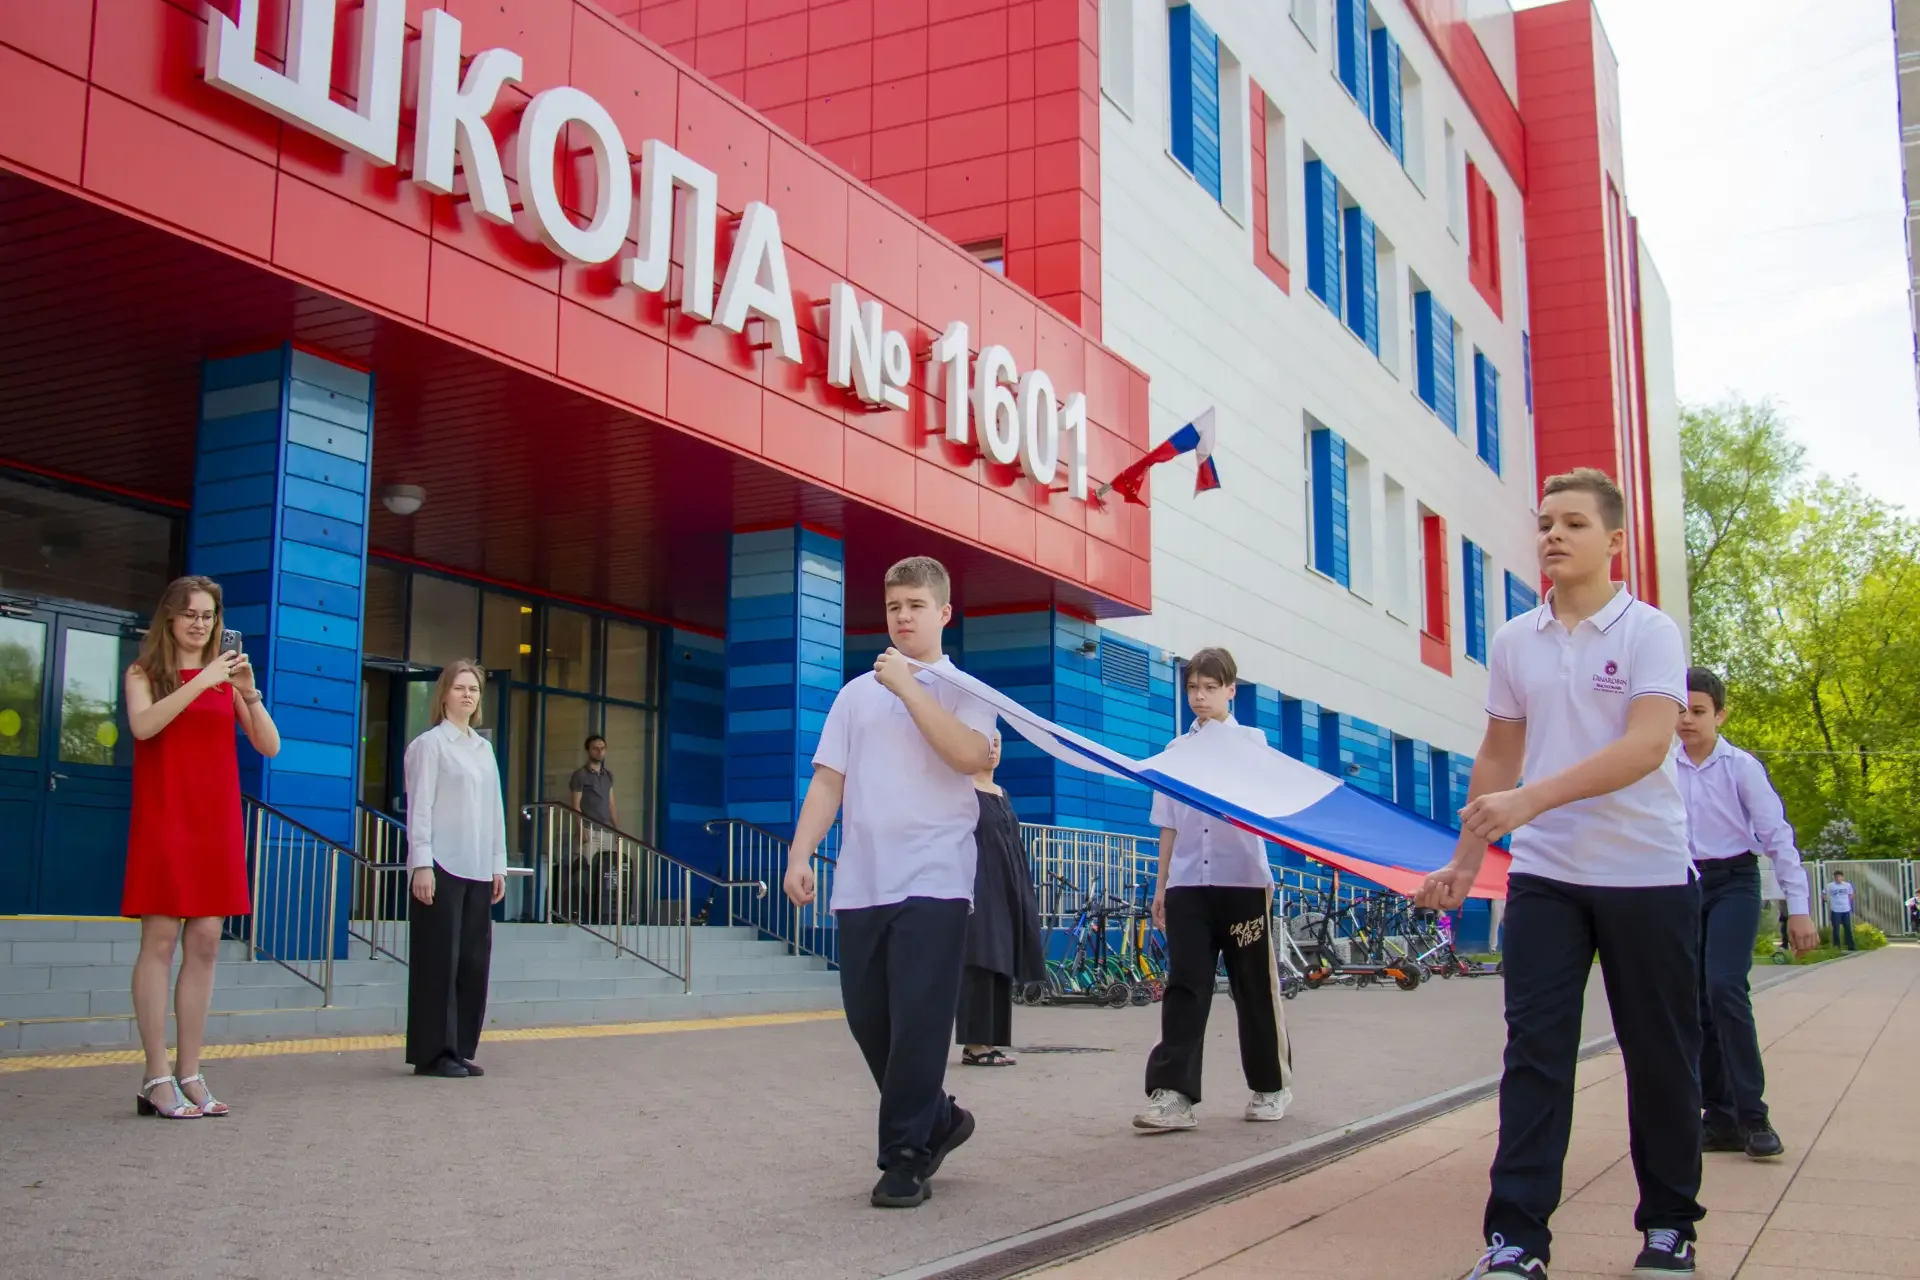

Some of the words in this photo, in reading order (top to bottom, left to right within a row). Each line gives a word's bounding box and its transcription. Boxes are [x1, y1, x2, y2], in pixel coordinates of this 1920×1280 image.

[204, 0, 802, 364] ШКОЛА
[828, 282, 911, 411] №
[932, 320, 1088, 500] 1601
[1229, 914, 1265, 936] CRAZY
